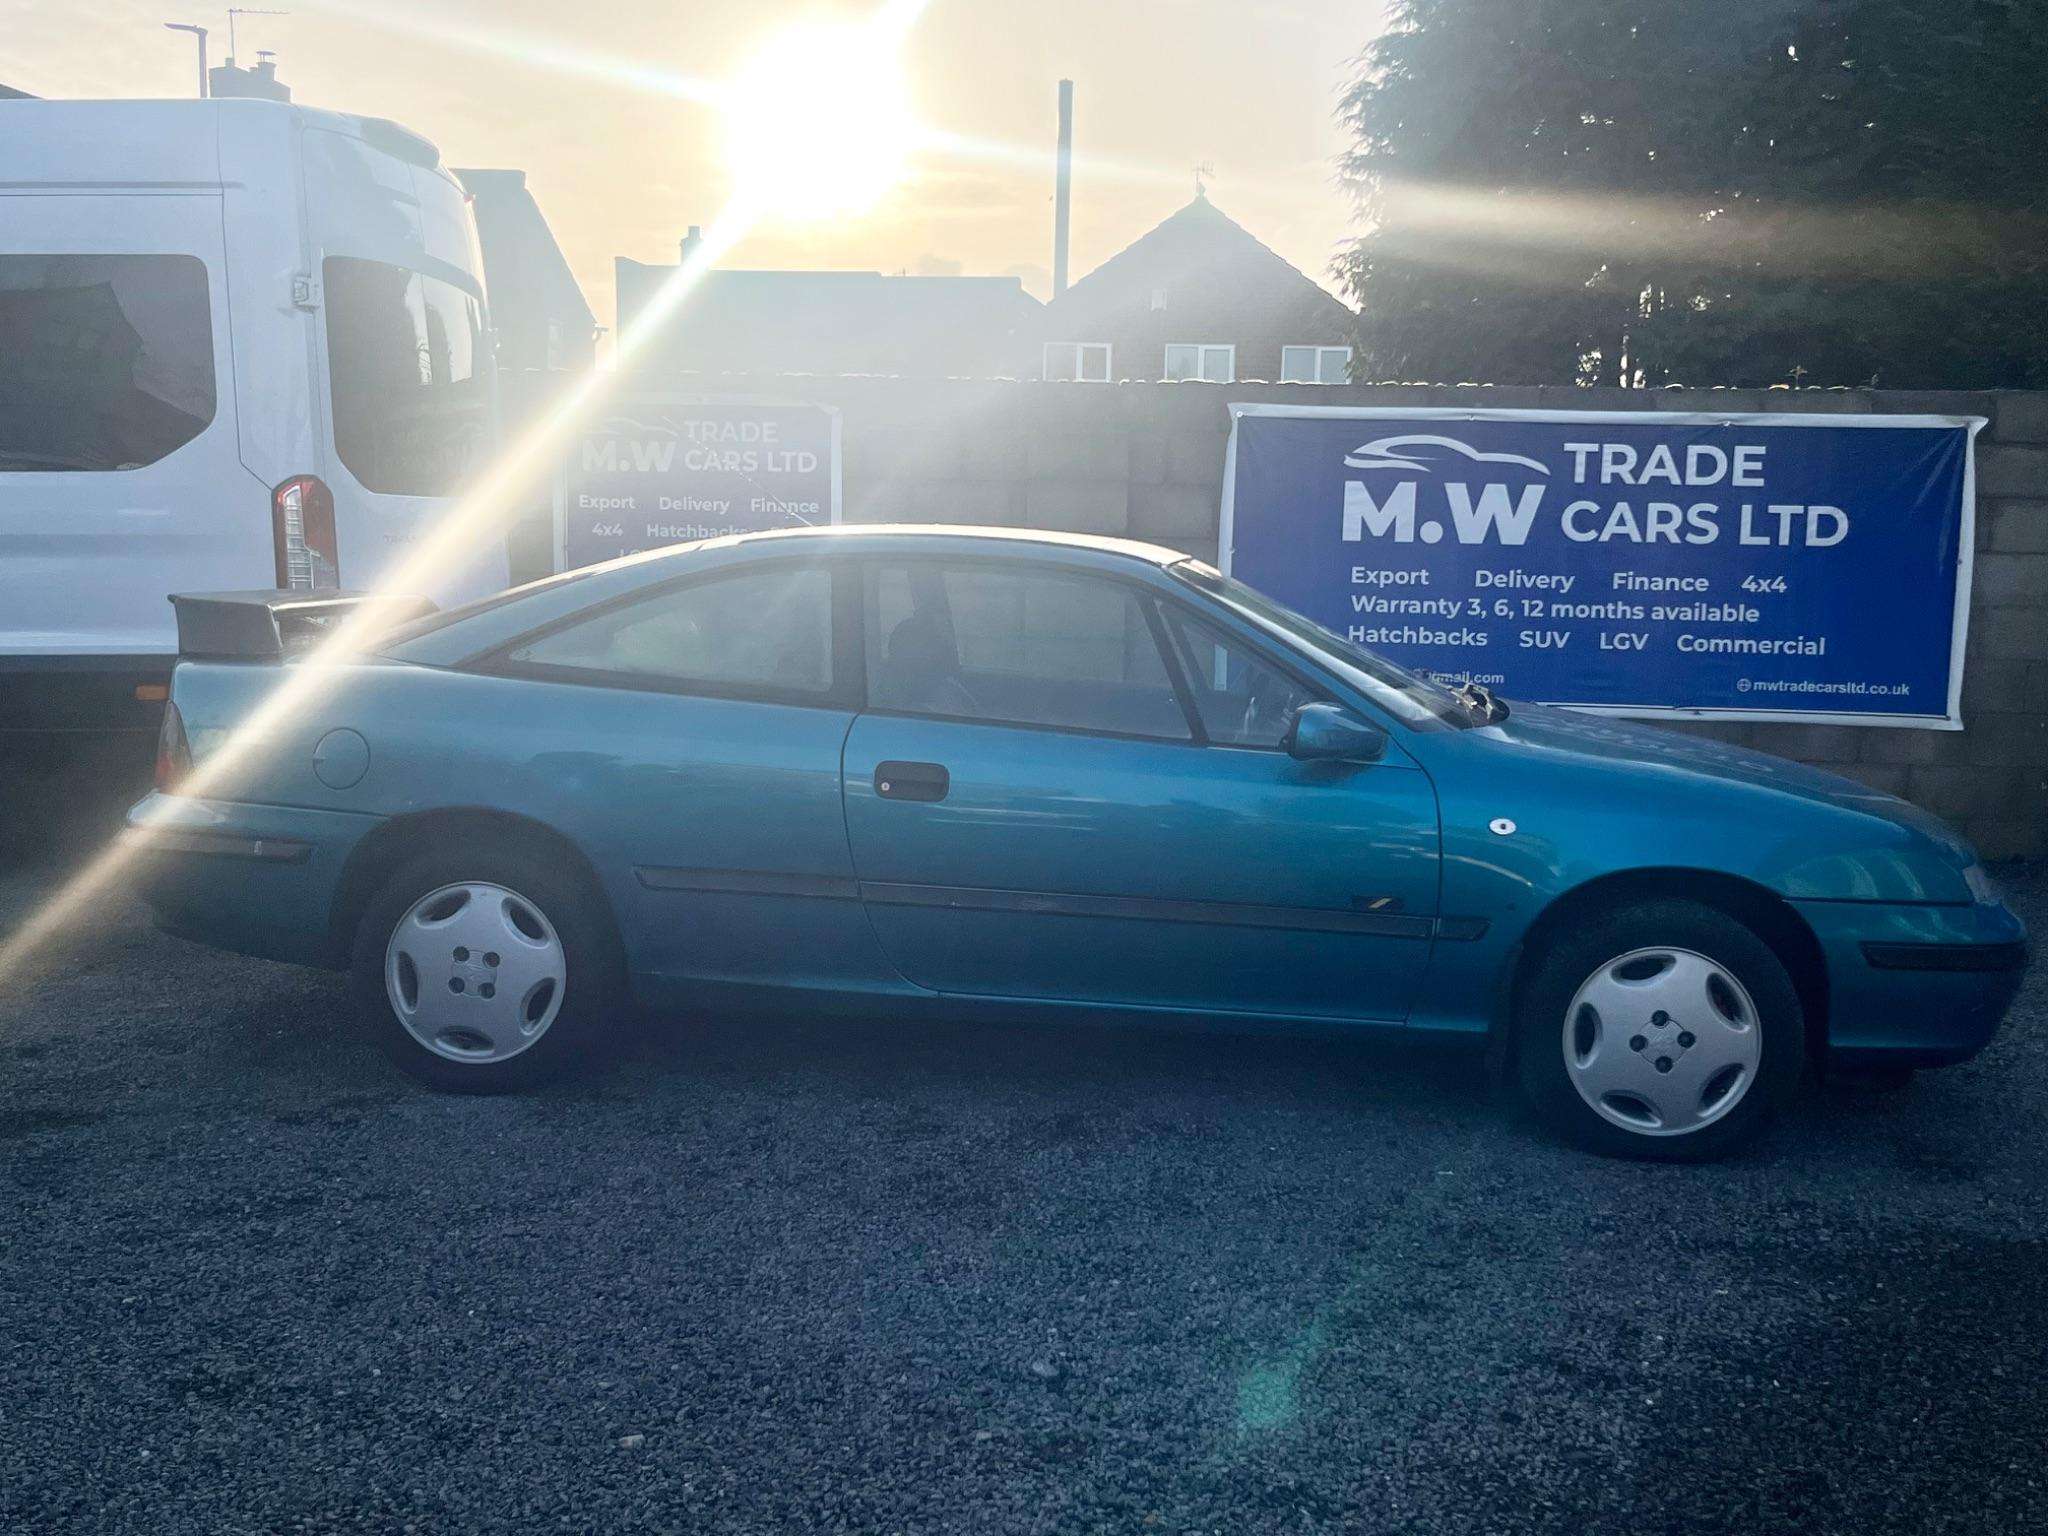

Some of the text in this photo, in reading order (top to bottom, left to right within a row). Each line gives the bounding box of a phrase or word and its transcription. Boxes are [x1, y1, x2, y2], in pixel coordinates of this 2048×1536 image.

[684, 421, 778, 443] TRADE
[581, 440, 677, 472] M.W
[685, 450, 818, 473] CARS LTD
[1564, 443, 1766, 487] TRADE
[579, 494, 819, 515] Export Delivery Finance
[1342, 481, 1546, 546] M.W
[592, 522, 623, 537] 4x4
[1561, 500, 1849, 547] CARS LTD
[1351, 566, 1787, 593] Export Delivery Finance 4x4
[1351, 595, 1760, 623] Warranty 3, 6, 12 months available
[1349, 626, 1826, 656] Hatchbacks SUV LGV Commercial
[1753, 680, 1910, 696] mwtradecarsltd.co.uk
